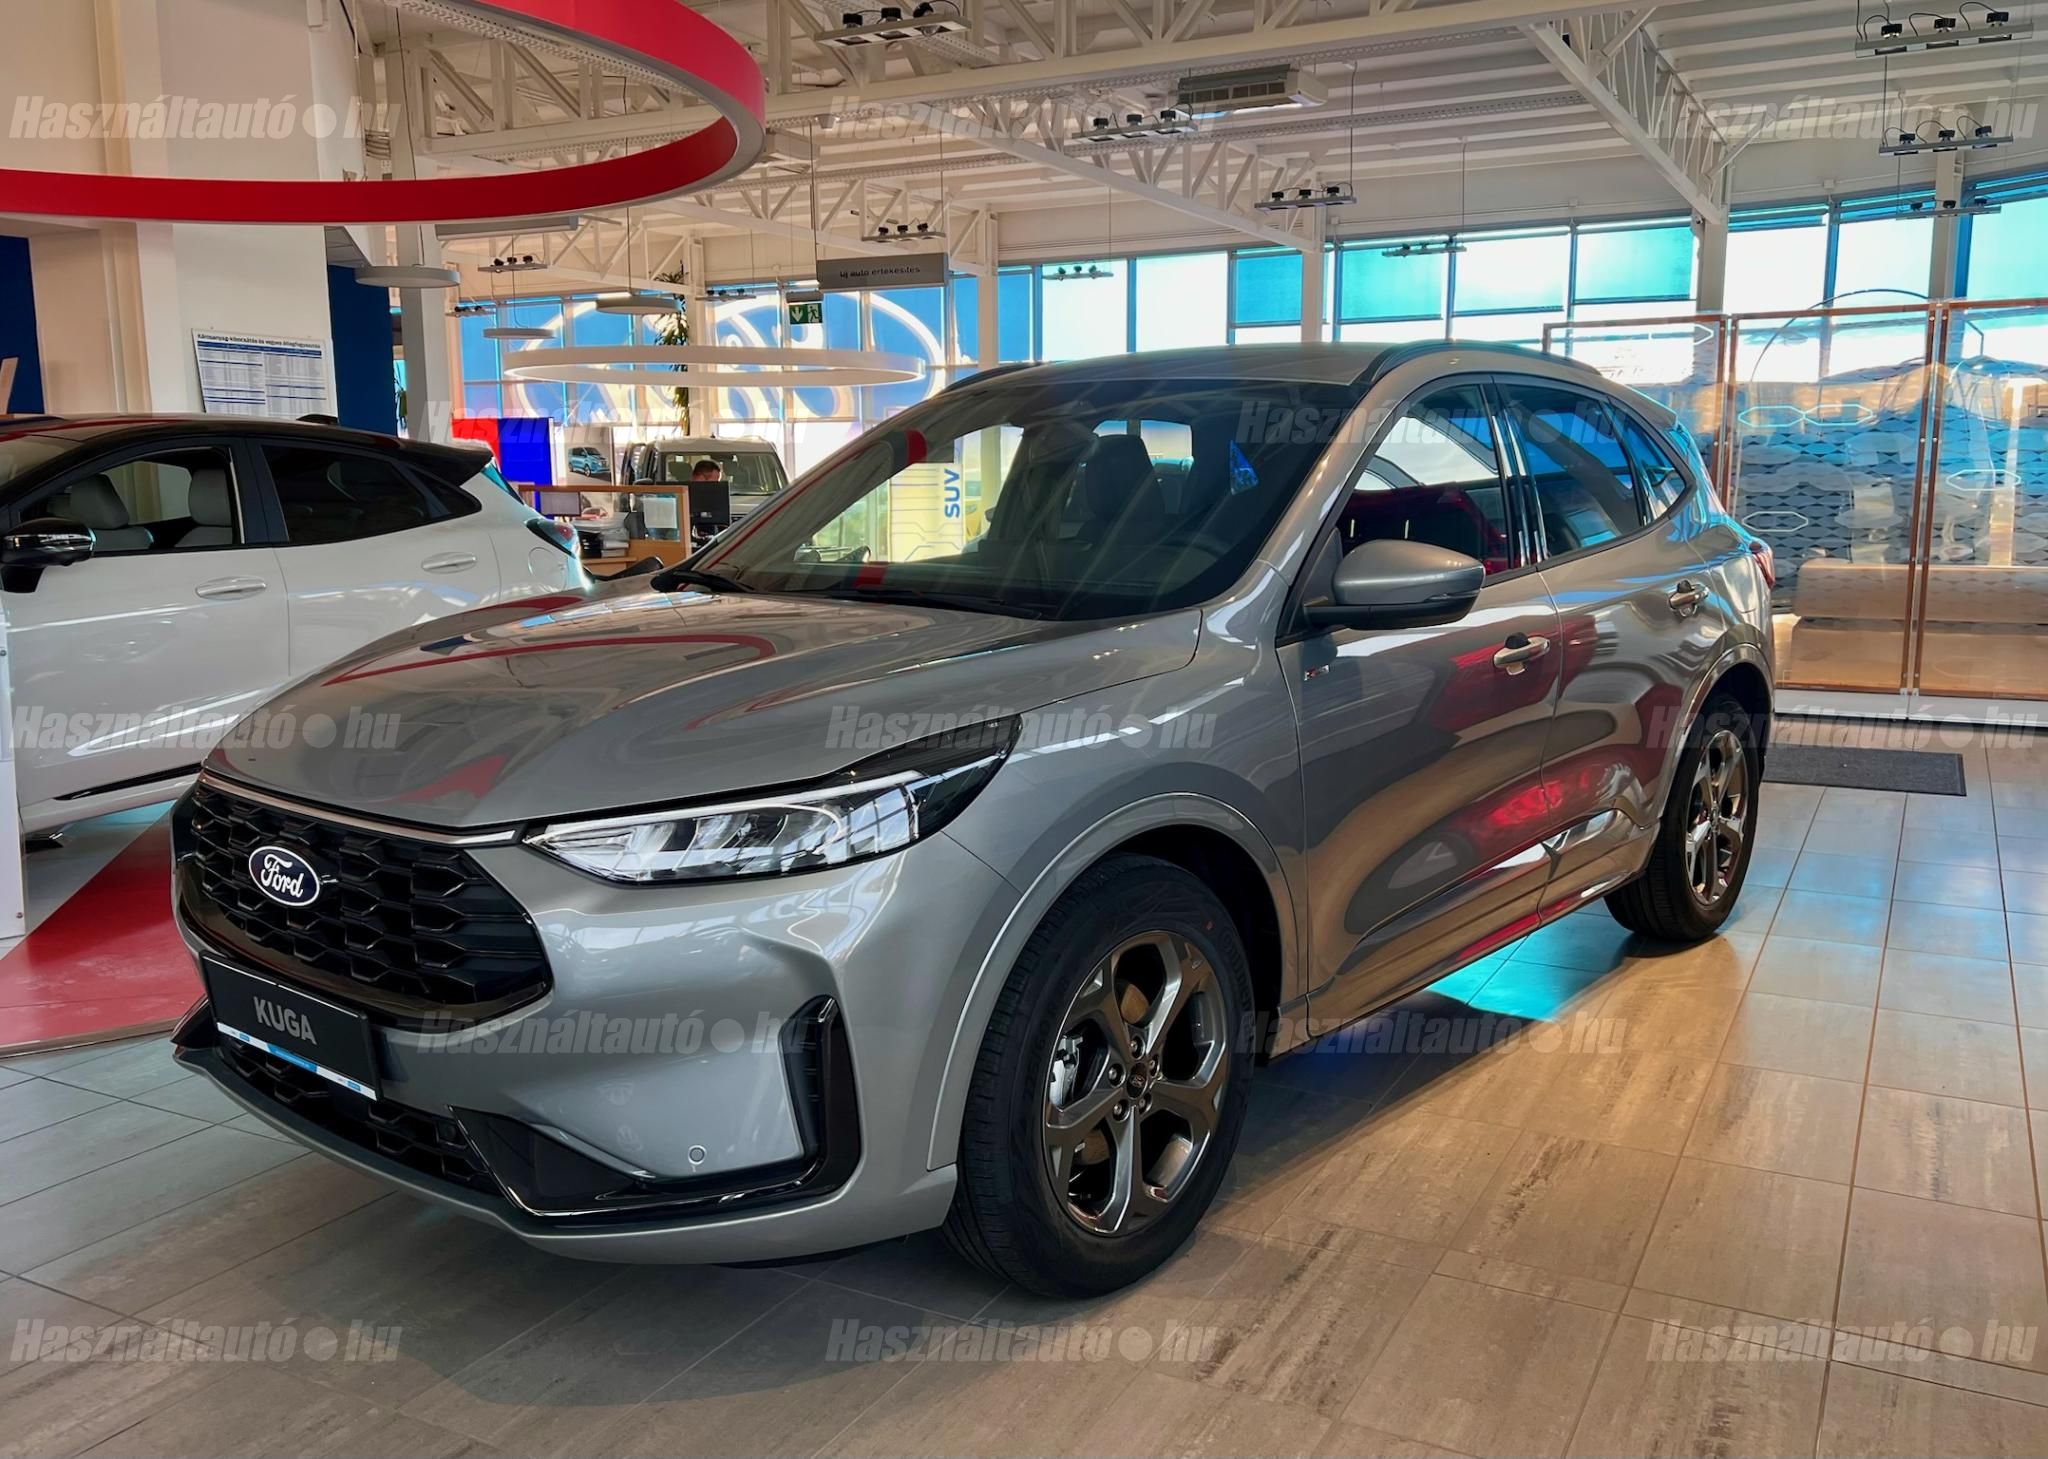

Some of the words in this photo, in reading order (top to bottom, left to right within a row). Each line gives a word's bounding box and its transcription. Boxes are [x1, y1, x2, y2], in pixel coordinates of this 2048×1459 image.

[944, 467, 961, 519] SUV
[260, 853, 305, 898] Ford
[253, 997, 318, 1045] KUGA
